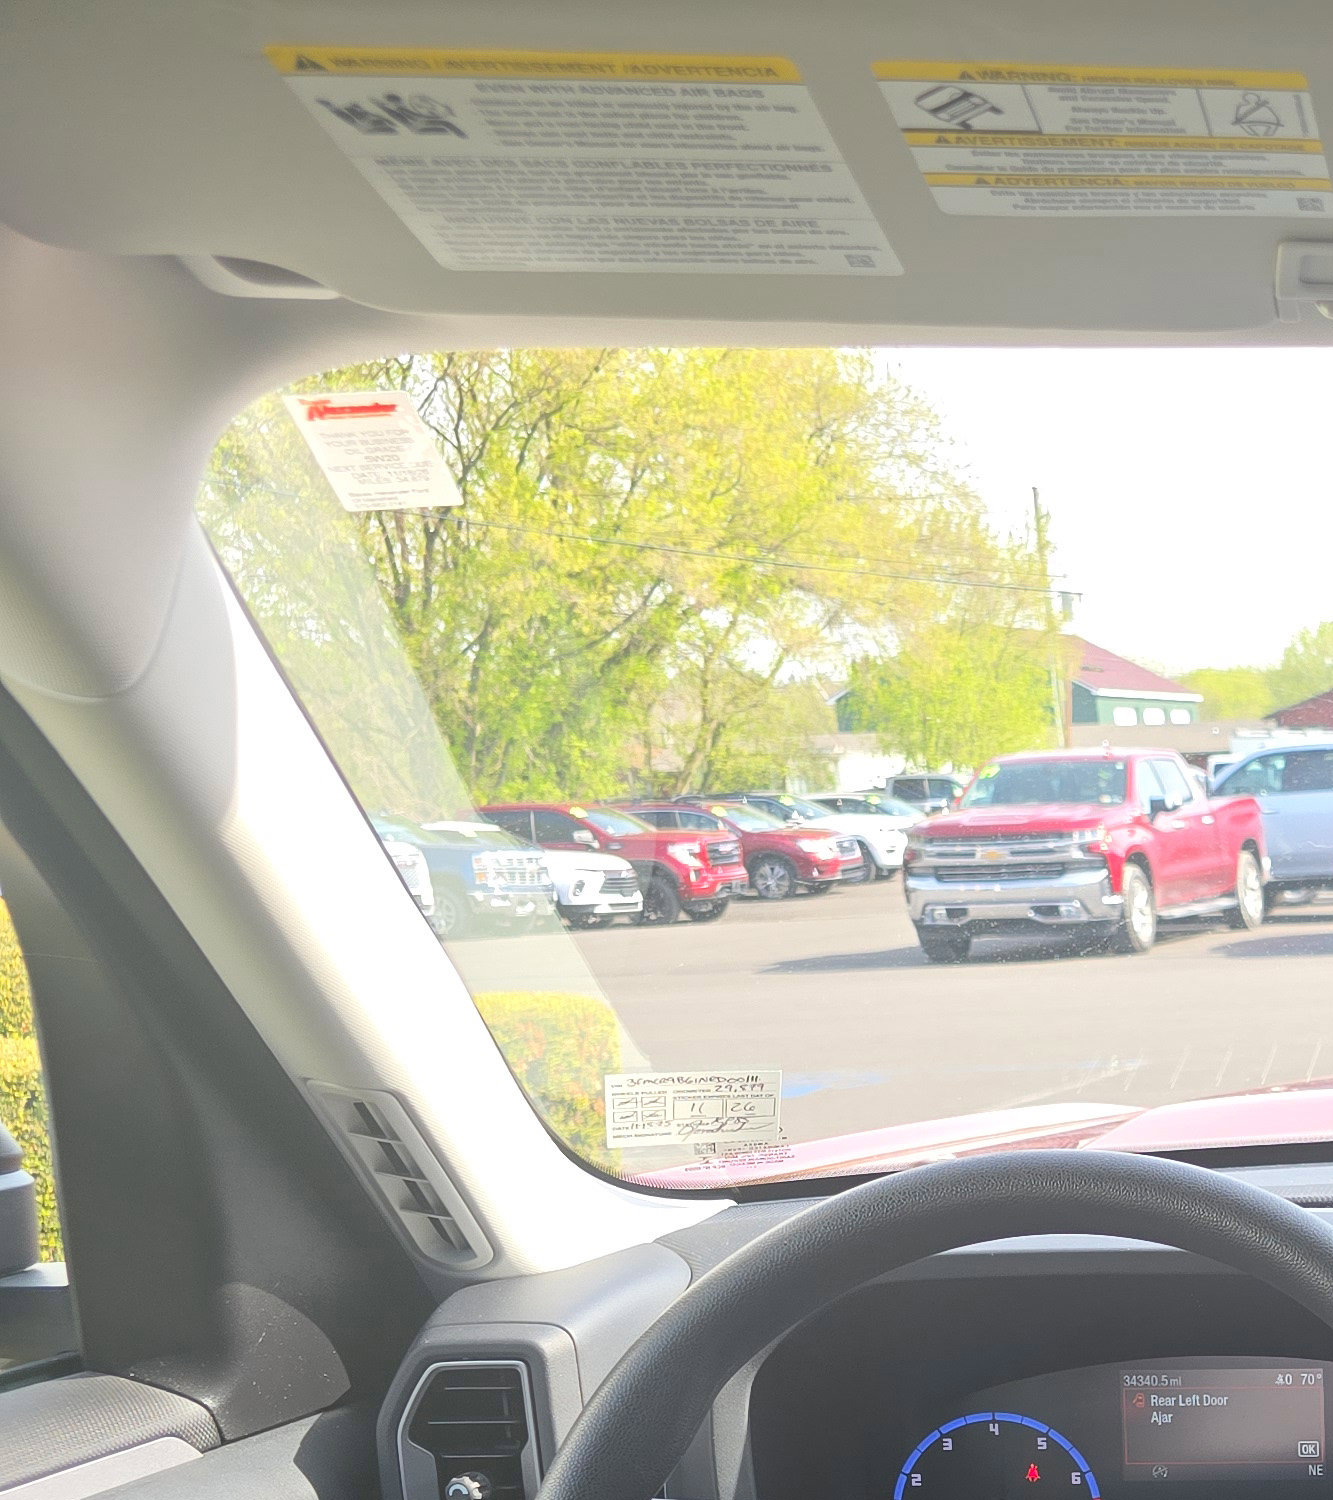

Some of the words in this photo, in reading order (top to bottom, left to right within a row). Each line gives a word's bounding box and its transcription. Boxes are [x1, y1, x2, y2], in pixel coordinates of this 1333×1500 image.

[1123, 1374, 1168, 1387] 34340.5
[1150, 1394, 1177, 1407] Rear
[1179, 1394, 1200, 1407] Left
[1203, 1394, 1229, 1406] Door
[1150, 1412, 1174, 1426] Ajar
[989, 1423, 999, 1436] 4
[942, 1437, 953, 1451] 3
[1037, 1436, 1047, 1450] 5
[1301, 1444, 1316, 1455] OK
[1308, 1464, 1324, 1476] NE
[911, 1473, 922, 1487] 2
[1071, 1471, 1081, 1485] 6
